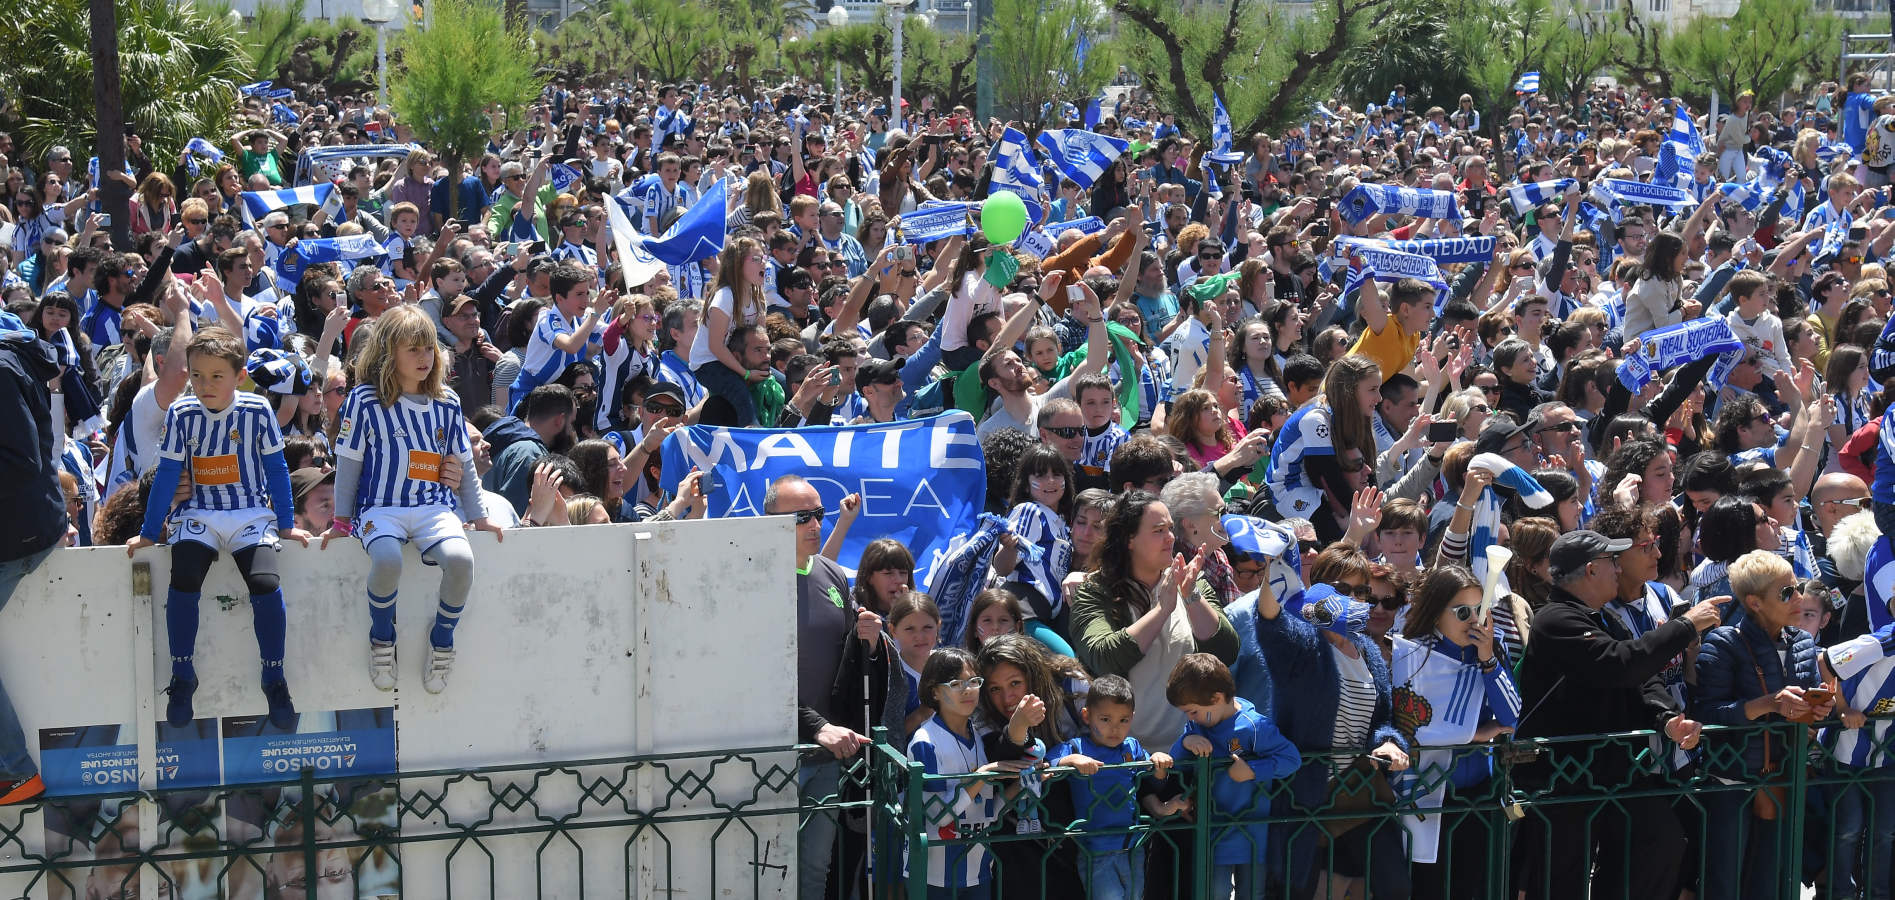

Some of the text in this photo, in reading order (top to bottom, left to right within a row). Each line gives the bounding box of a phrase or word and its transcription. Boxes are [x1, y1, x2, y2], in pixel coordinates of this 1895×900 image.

[1396, 191, 1449, 210] SOCIEDAD
[1661, 334, 1684, 354] REAL
[674, 413, 983, 473] MAITE
[410, 461, 440, 472] euskalte
[706, 476, 951, 519] ADEA
[166, 755, 179, 764] LA
[261, 743, 357, 757] LA VOZ QUE NOS UNE
[80, 760, 101, 769] UNE
[101, 759, 122, 767] NOS
[275, 754, 357, 773] ALONSO
[94, 765, 179, 785] ALNSO
